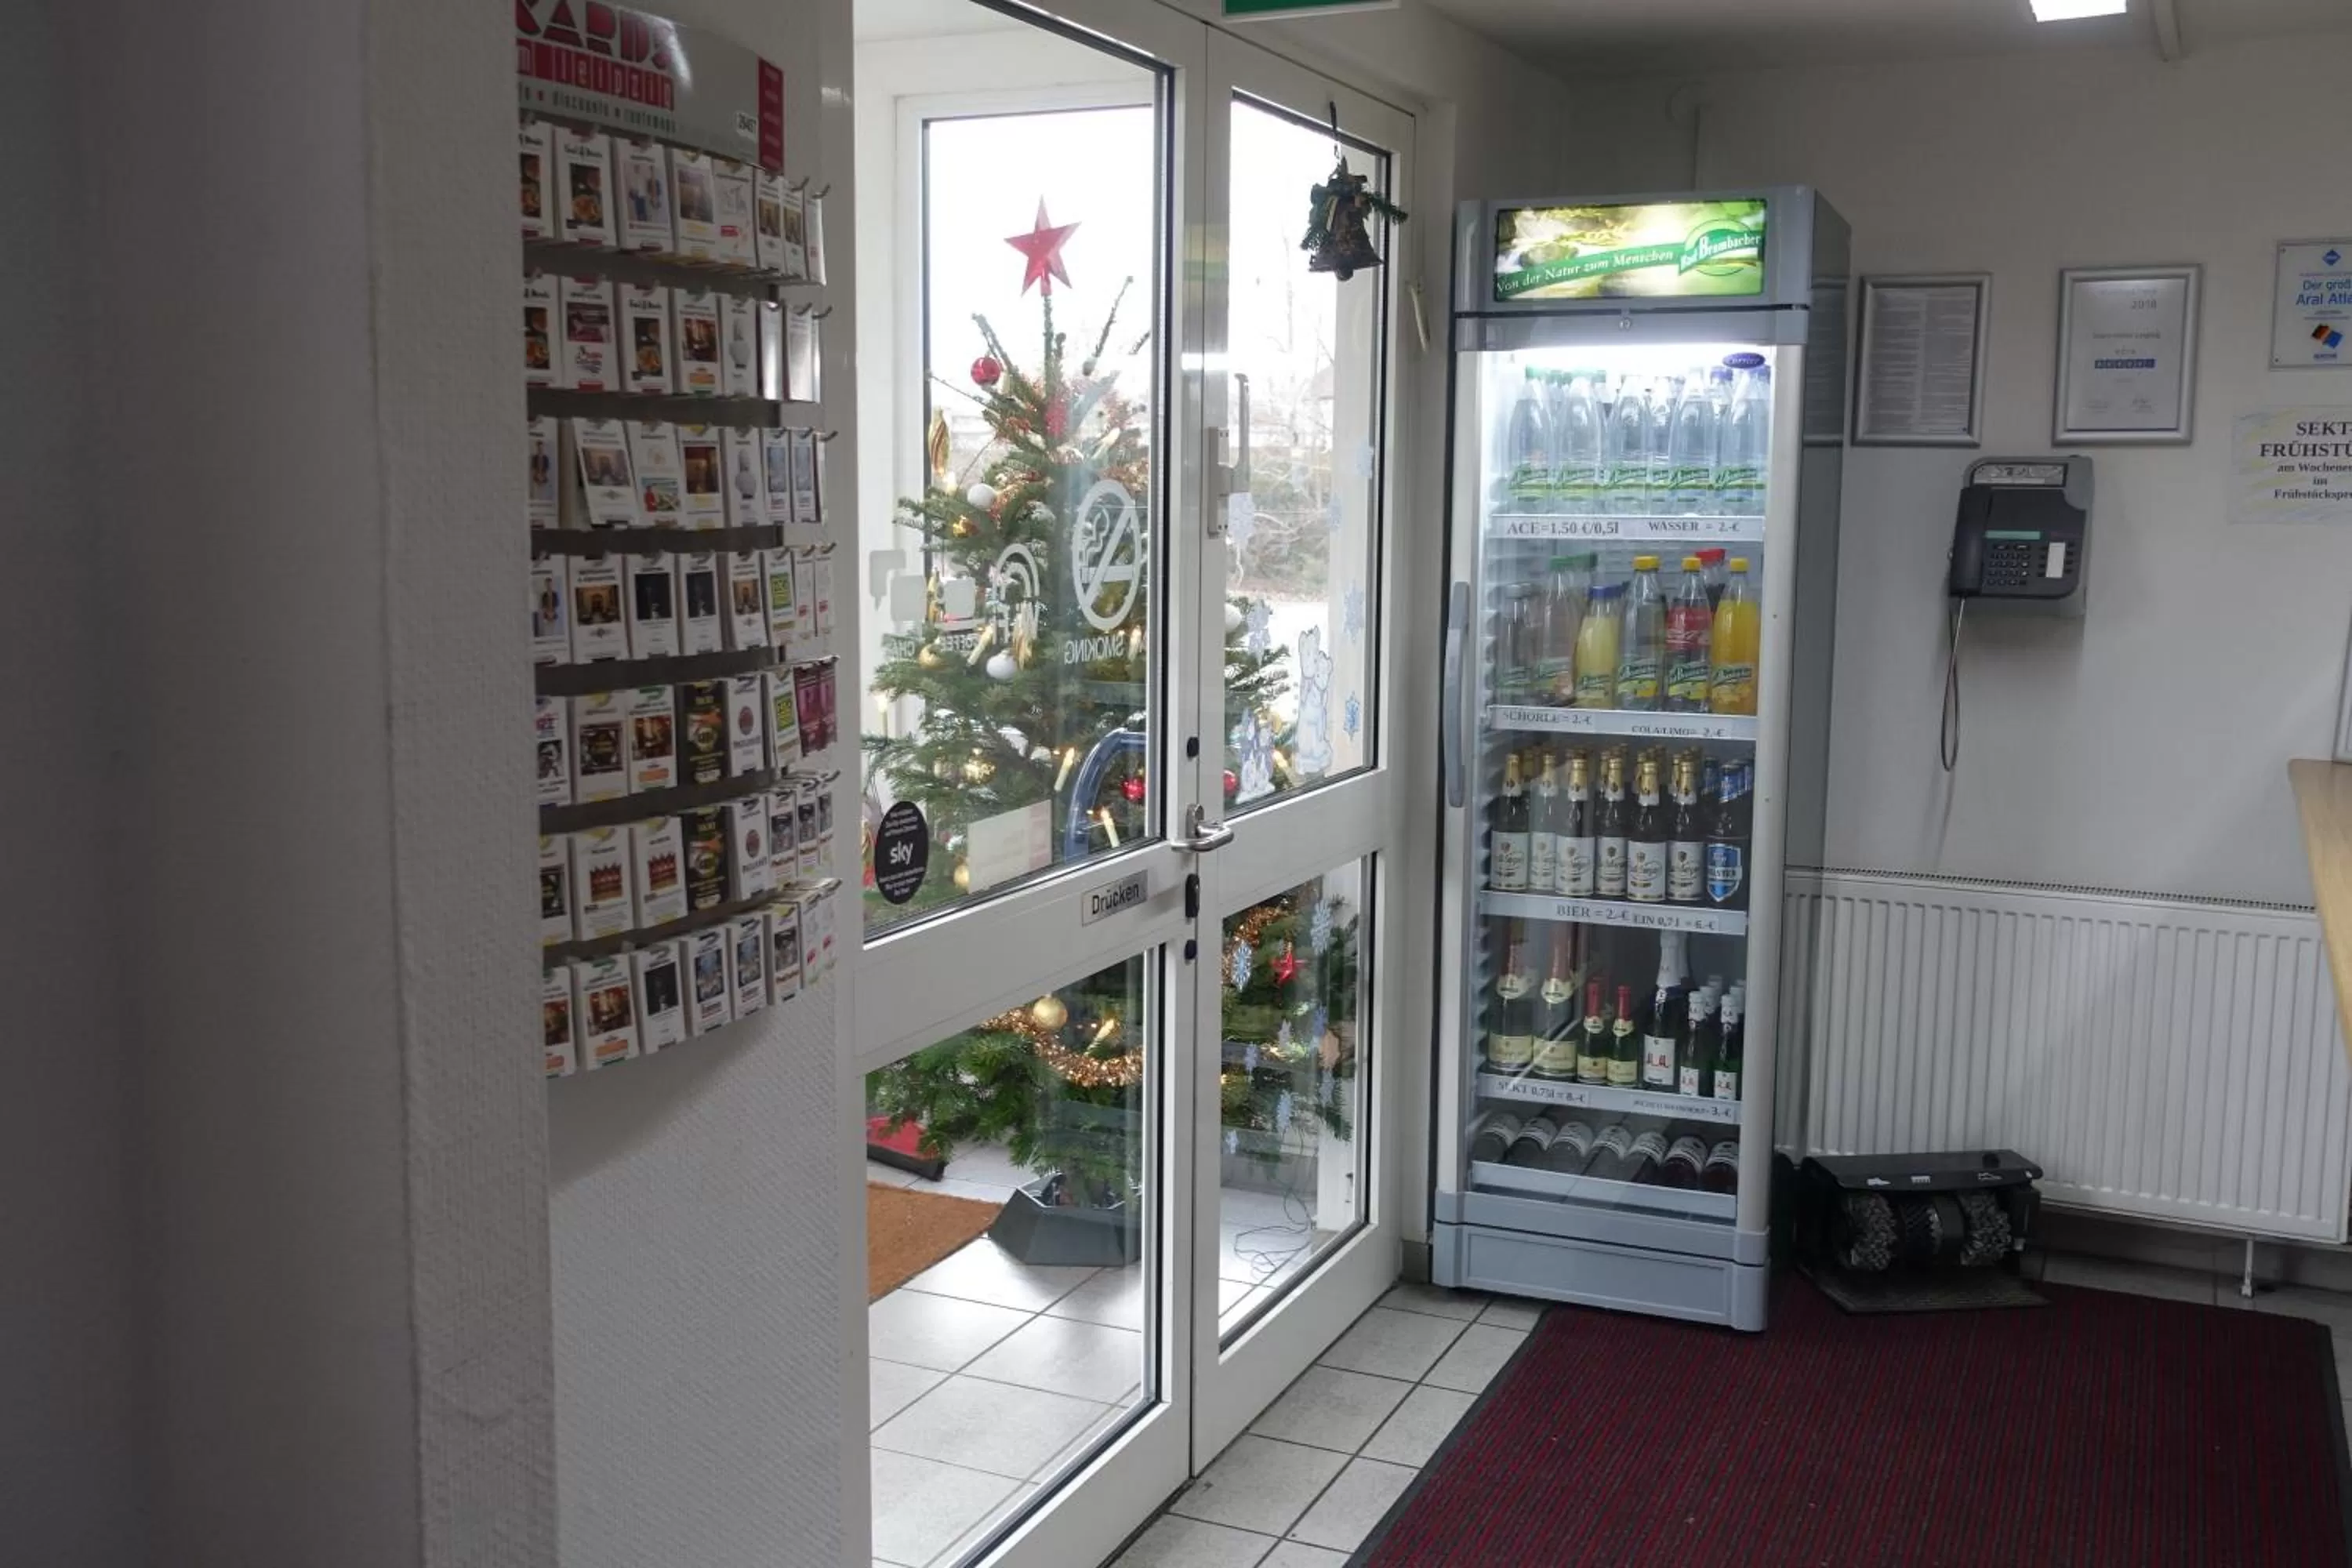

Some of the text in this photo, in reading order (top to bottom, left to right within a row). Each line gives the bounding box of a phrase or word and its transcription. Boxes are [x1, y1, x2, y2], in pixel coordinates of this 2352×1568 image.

[1699, 232, 1761, 260] Brambacher
[1497, 249, 1674, 292] Von der Natur zum Menschen
[2303, 280, 2322, 291] Der
[2296, 293, 2323, 305] Aral
[2277, 464, 2295, 473] am
[2313, 476, 2328, 485] im
[1648, 521, 1699, 533] WASSER
[890, 840, 913, 866] sky
[1092, 883, 1139, 915] Drücken
[1556, 904, 1591, 918] BIER
